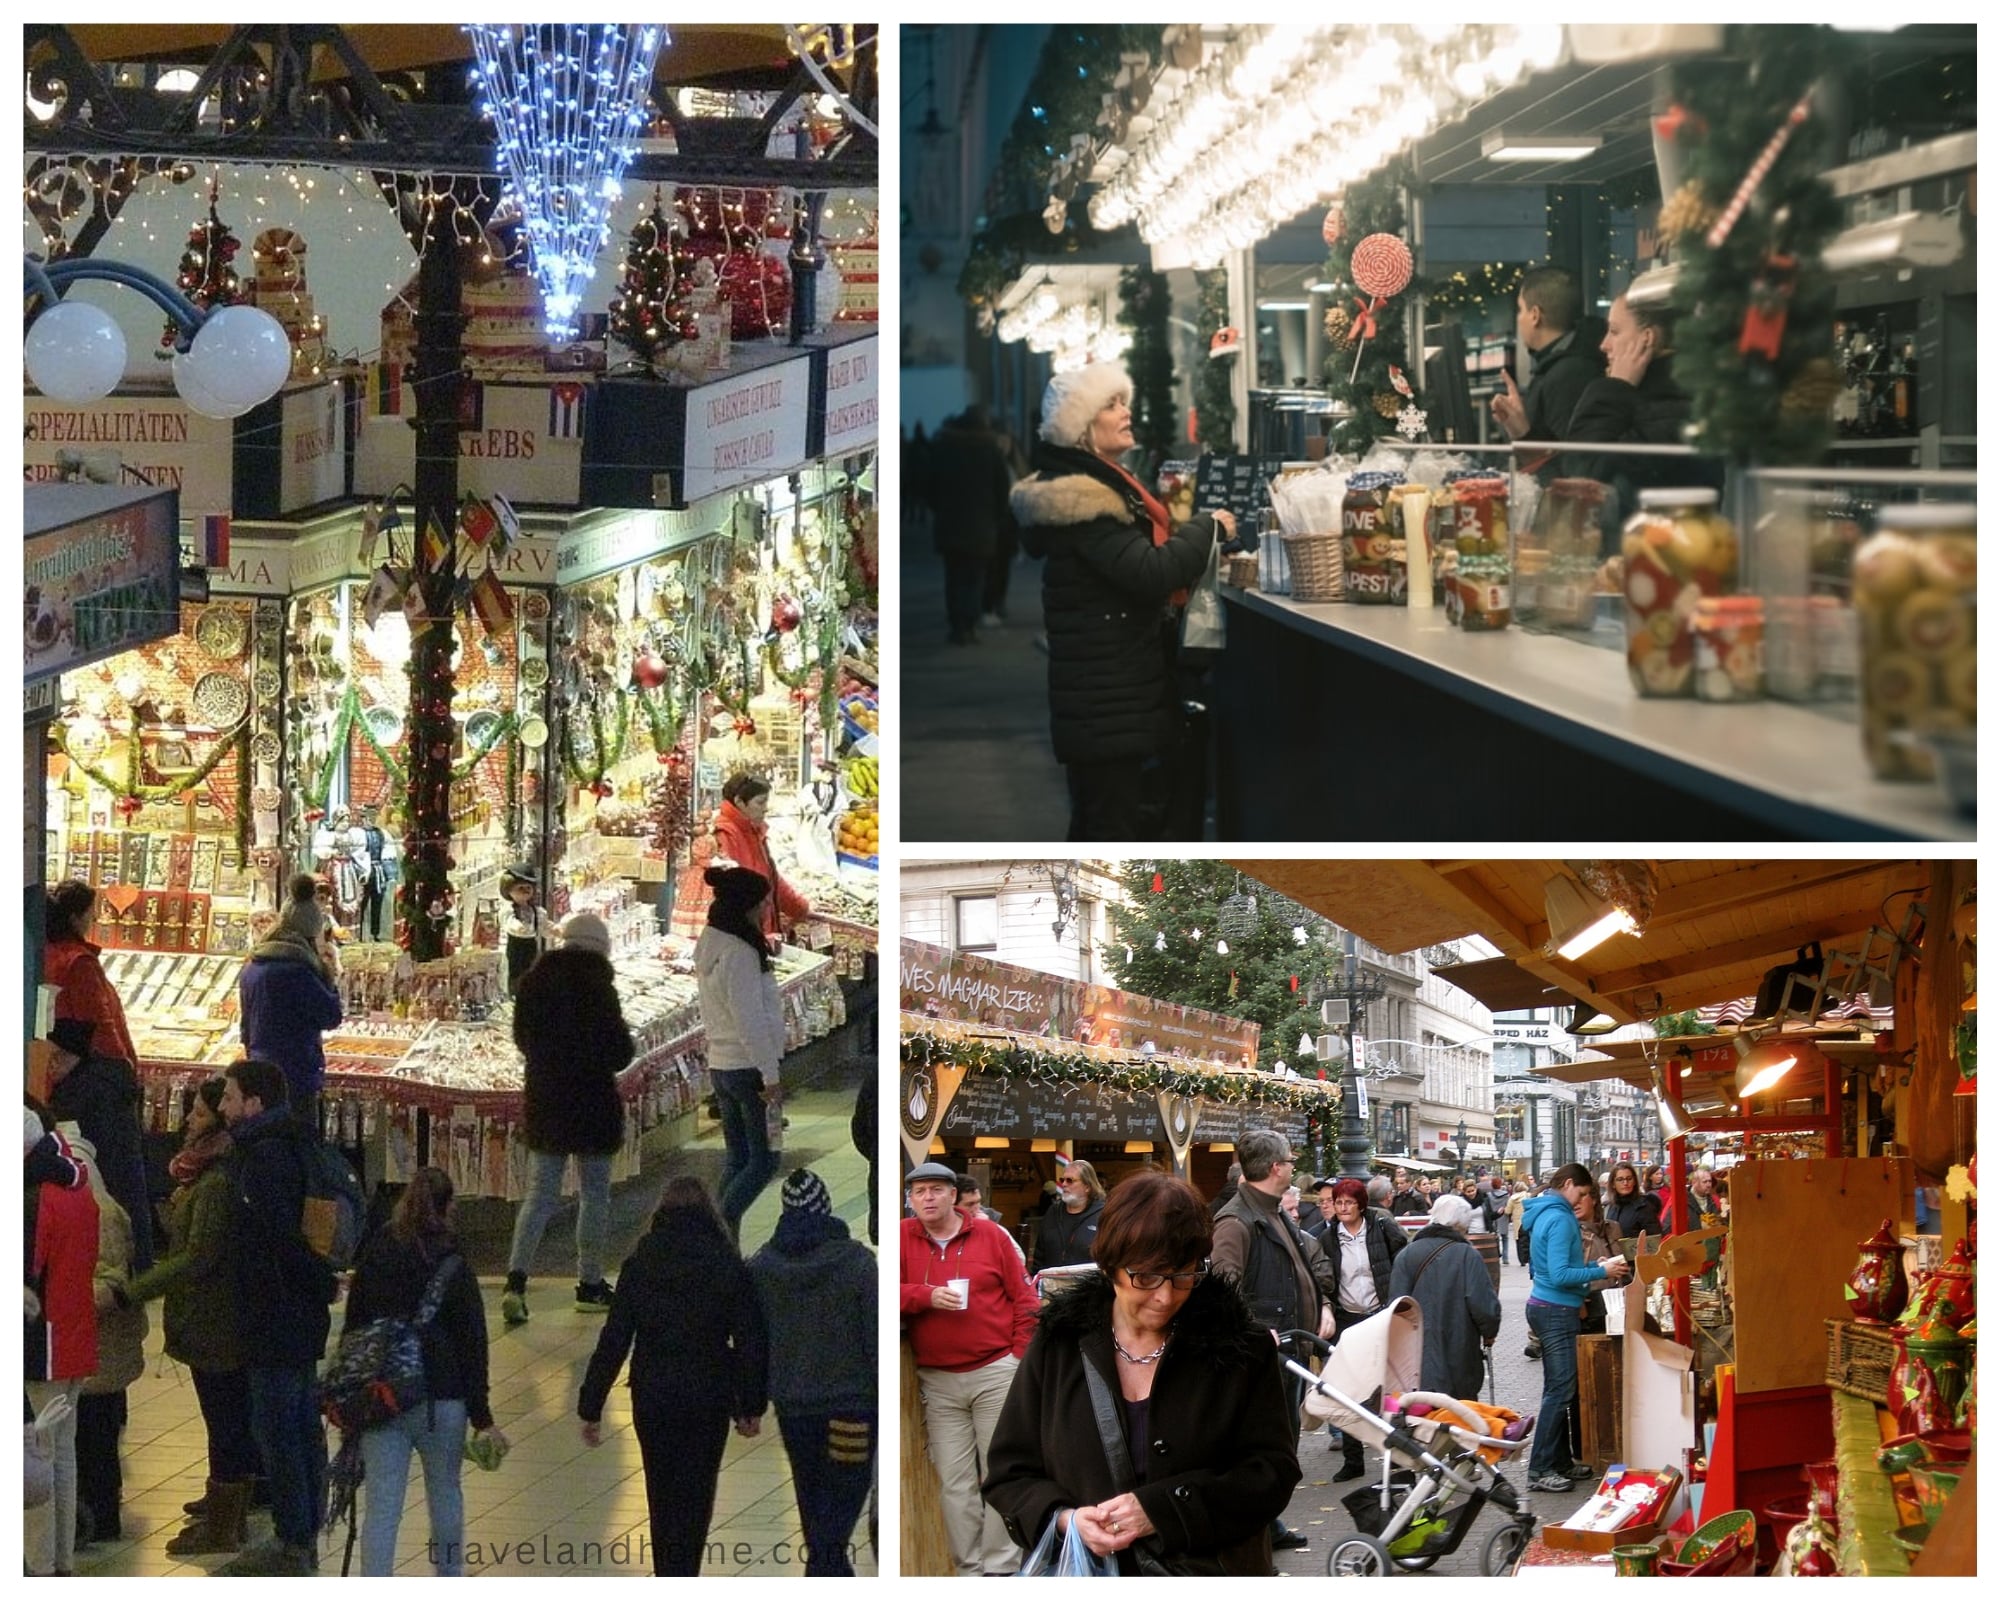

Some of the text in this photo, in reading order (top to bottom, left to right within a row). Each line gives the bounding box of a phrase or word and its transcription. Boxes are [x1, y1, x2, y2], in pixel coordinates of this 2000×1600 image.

[28, 409, 188, 442] SPEZIALITÄTEN
[457, 428, 535, 460] REBS
[938, 972, 1002, 1012] MAGYAR
[1526, 1027, 1549, 1038] HÁZ
